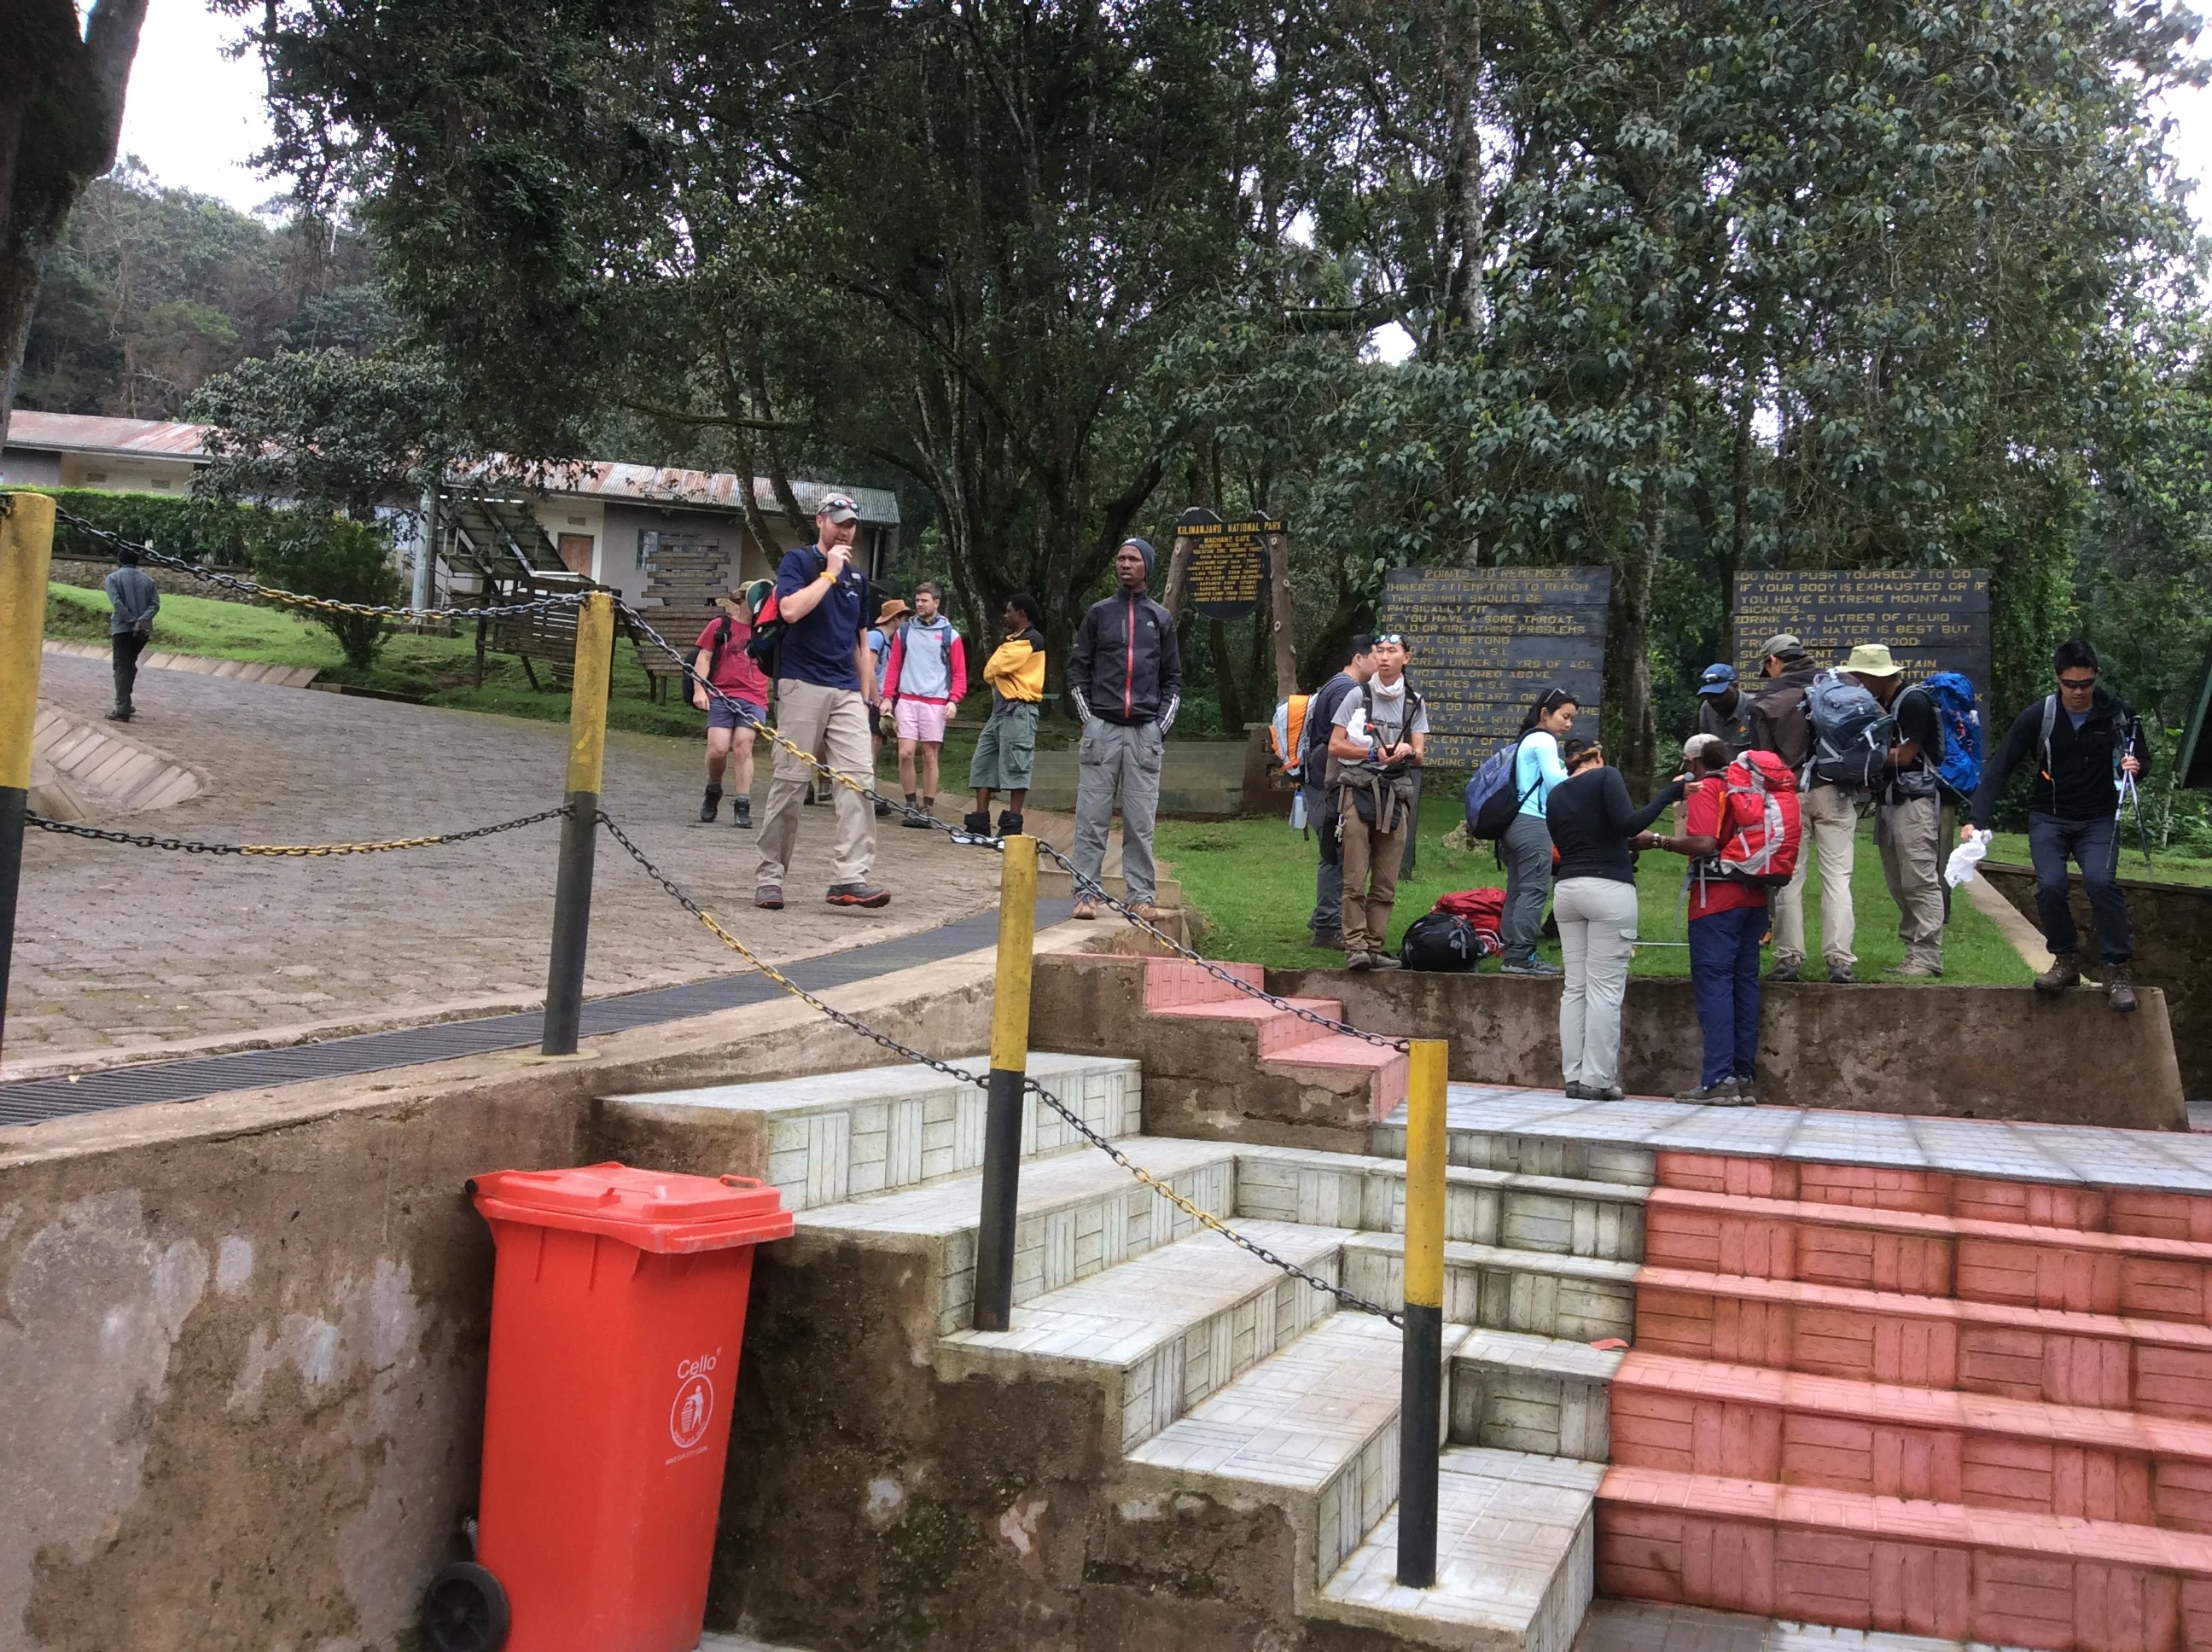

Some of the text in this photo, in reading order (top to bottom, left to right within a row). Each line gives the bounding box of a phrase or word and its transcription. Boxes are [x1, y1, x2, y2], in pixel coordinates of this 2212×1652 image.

[1178, 521, 1282, 534] KILIMANJARO NATIONAL PARK
[1424, 568, 1570, 579] POINTS TO REMEMBER
[1764, 572, 1793, 580] NOT
[1799, 571, 1837, 580] PUSH
[1844, 570, 1920, 580] YOURSELF
[1929, 570, 1945, 579] TO
[1952, 570, 1971, 579] GO
[1440, 583, 1516, 592] ATTEMPTING
[1524, 583, 1540, 591] TO
[1545, 583, 1588, 592] REACH
[1739, 581, 1987, 592] IF YOUR BODY IS EXHAUSTED OR IF
[1391, 594, 1414, 602] THE
[1470, 594, 1520, 603] SHOULD
[1526, 594, 1542, 603] BE
[1740, 594, 1963, 604] YOU HAVE EXTREME MOUNTAIN
[1387, 604, 1488, 614] PHYSICALLY FIT
[1404, 614, 1427, 623] YOU
[1431, 614, 1464, 623] HAVE
[1484, 614, 1516, 624] SORE
[1824, 613, 1876, 623] LITRES
[1881, 613, 1901, 622] OF
[1907, 613, 1950, 622] FLUID
[1386, 624, 1585, 634] COLD OR BREATHING PROBLEMS
[1739, 626, 1778, 636] EACH
[1822, 625, 1870, 635] WATER
[1876, 625, 1889, 634] IS
[1895, 625, 1936, 634] BEST
[1941, 625, 1971, 634] BUT
[1459, 636, 1510, 644] BEYOND
[1422, 647, 1472, 655] METRES
[1450, 658, 1491, 667] UNDER
[1516, 660, 1540, 668] YRS
[1546, 660, 1563, 668] OF
[1569, 660, 1595, 670] AGE
[1444, 669, 1503, 678] ALLOWED
[1509, 671, 1551, 679] ABOVE
[1419, 679, 1470, 689] METRES
[1429, 691, 1537, 702] HAVE HEART OR
[1446, 702, 1463, 711] DO
[1468, 703, 1493, 712] NOT
[1439, 713, 1455, 722] AT
[1461, 714, 1486, 724] ALL
[1455, 724, 1487, 734] YOUR
[1423, 735, 1475, 744] PLENTY
[1480, 736, 1498, 746] OF
[1443, 747, 1459, 756] TO
[677, 1353, 718, 1379] Cello
